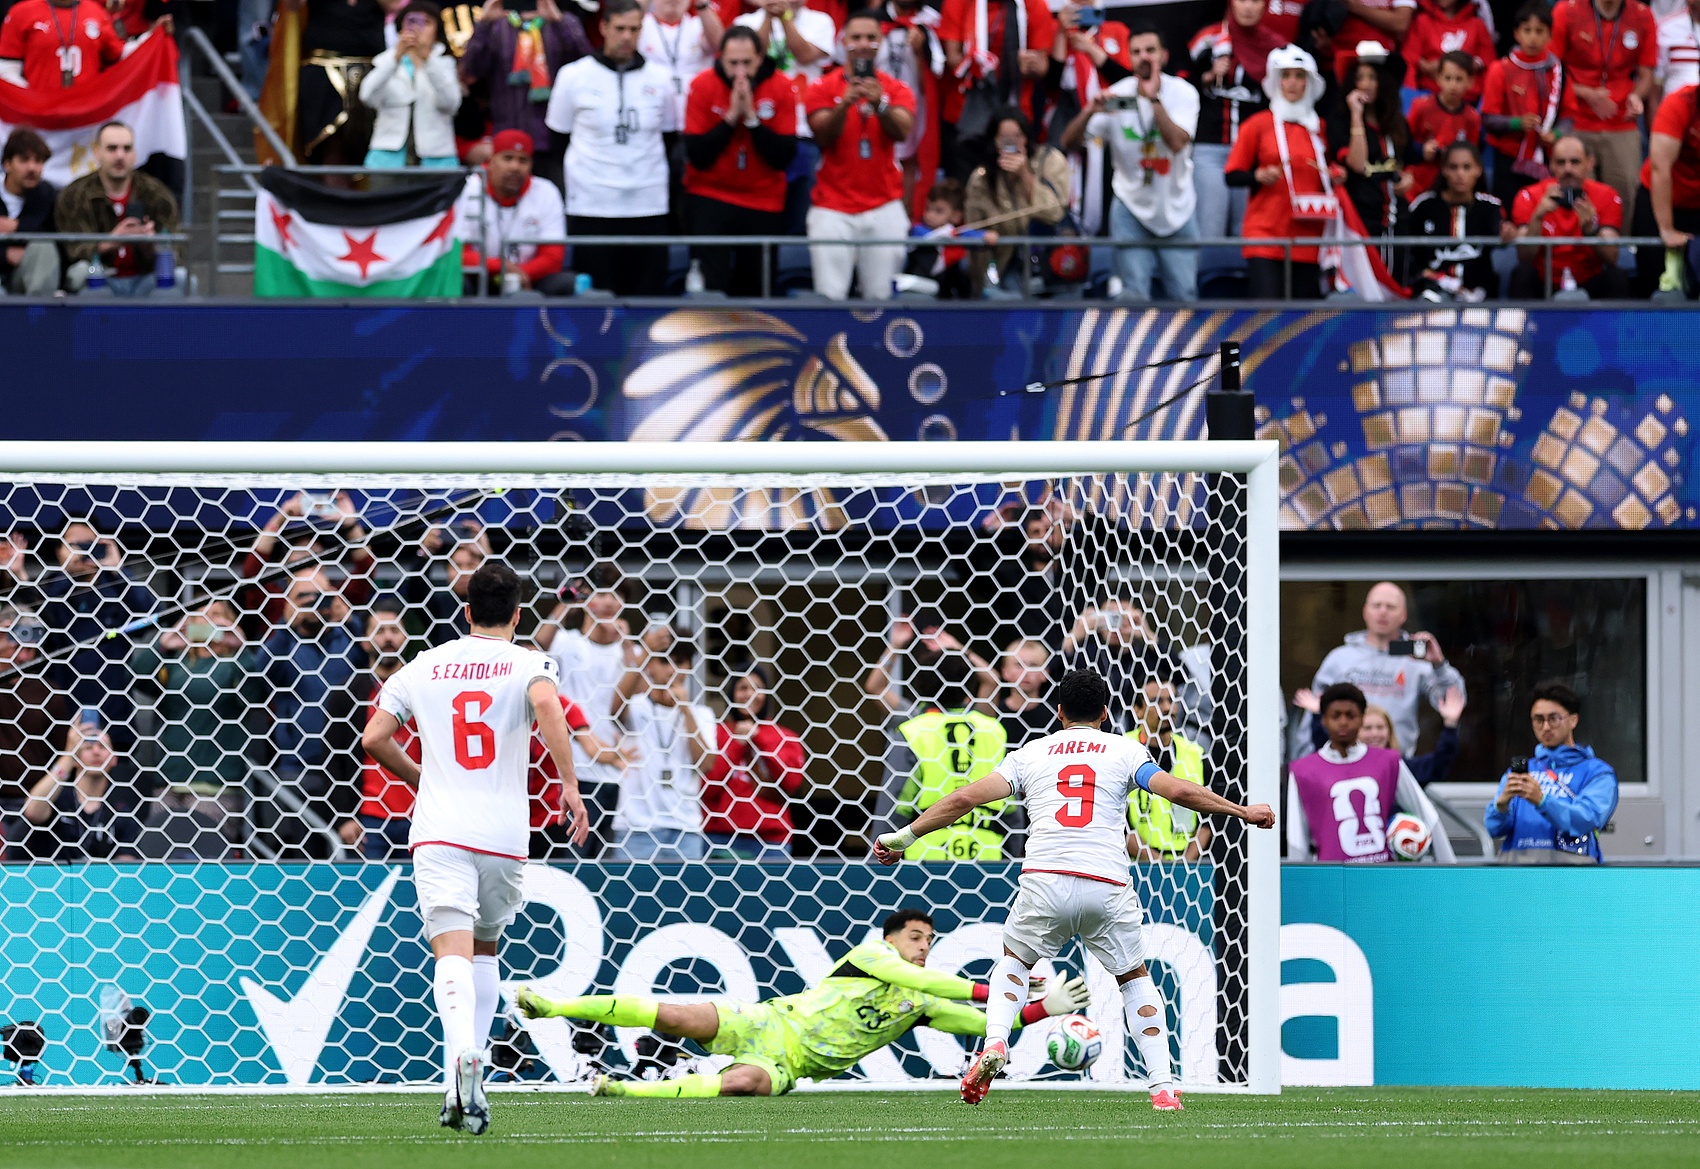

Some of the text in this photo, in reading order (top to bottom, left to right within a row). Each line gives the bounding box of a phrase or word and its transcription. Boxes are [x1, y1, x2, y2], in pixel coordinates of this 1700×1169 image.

[55, 45, 82, 77] 10
[431, 661, 513, 680] S.EZATOLAHI
[452, 691, 495, 770] 6
[1048, 741, 1107, 755] TAREMI
[1055, 764, 1096, 828] 9
[856, 1005, 891, 1030] 23
